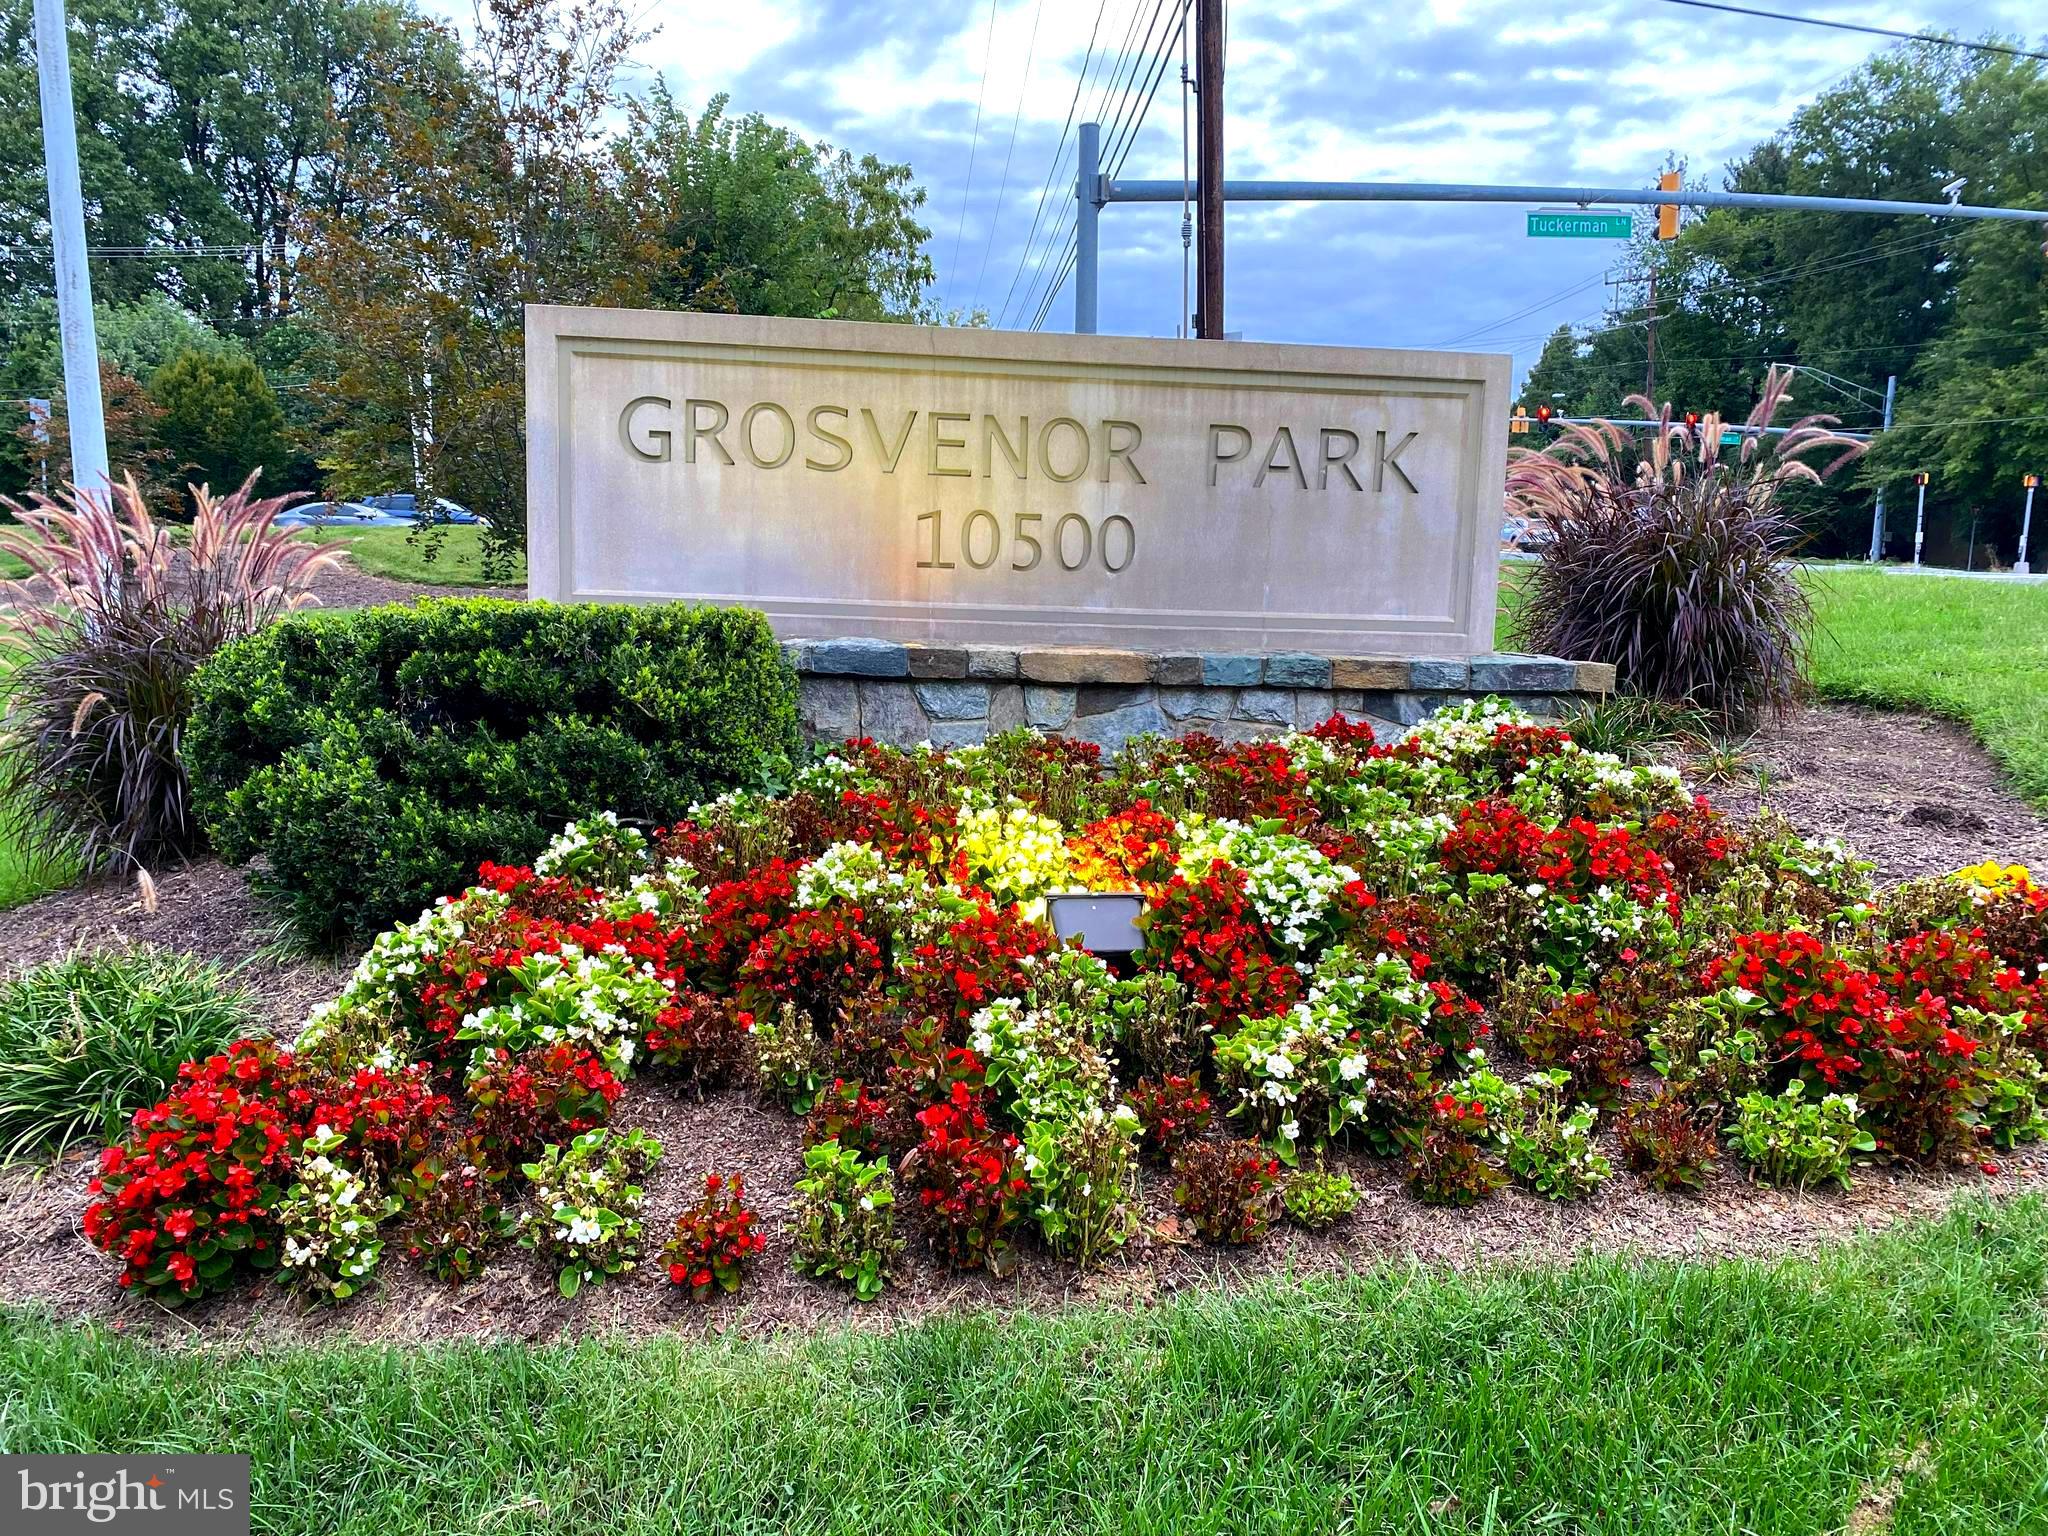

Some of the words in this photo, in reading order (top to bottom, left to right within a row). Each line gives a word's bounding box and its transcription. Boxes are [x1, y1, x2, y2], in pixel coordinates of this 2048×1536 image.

[1530, 218, 1608, 233] Tuckerman
[617, 395, 1147, 486] GROSVENOR
[1206, 423, 1419, 494] PARK
[916, 509, 1136, 574] 10500
